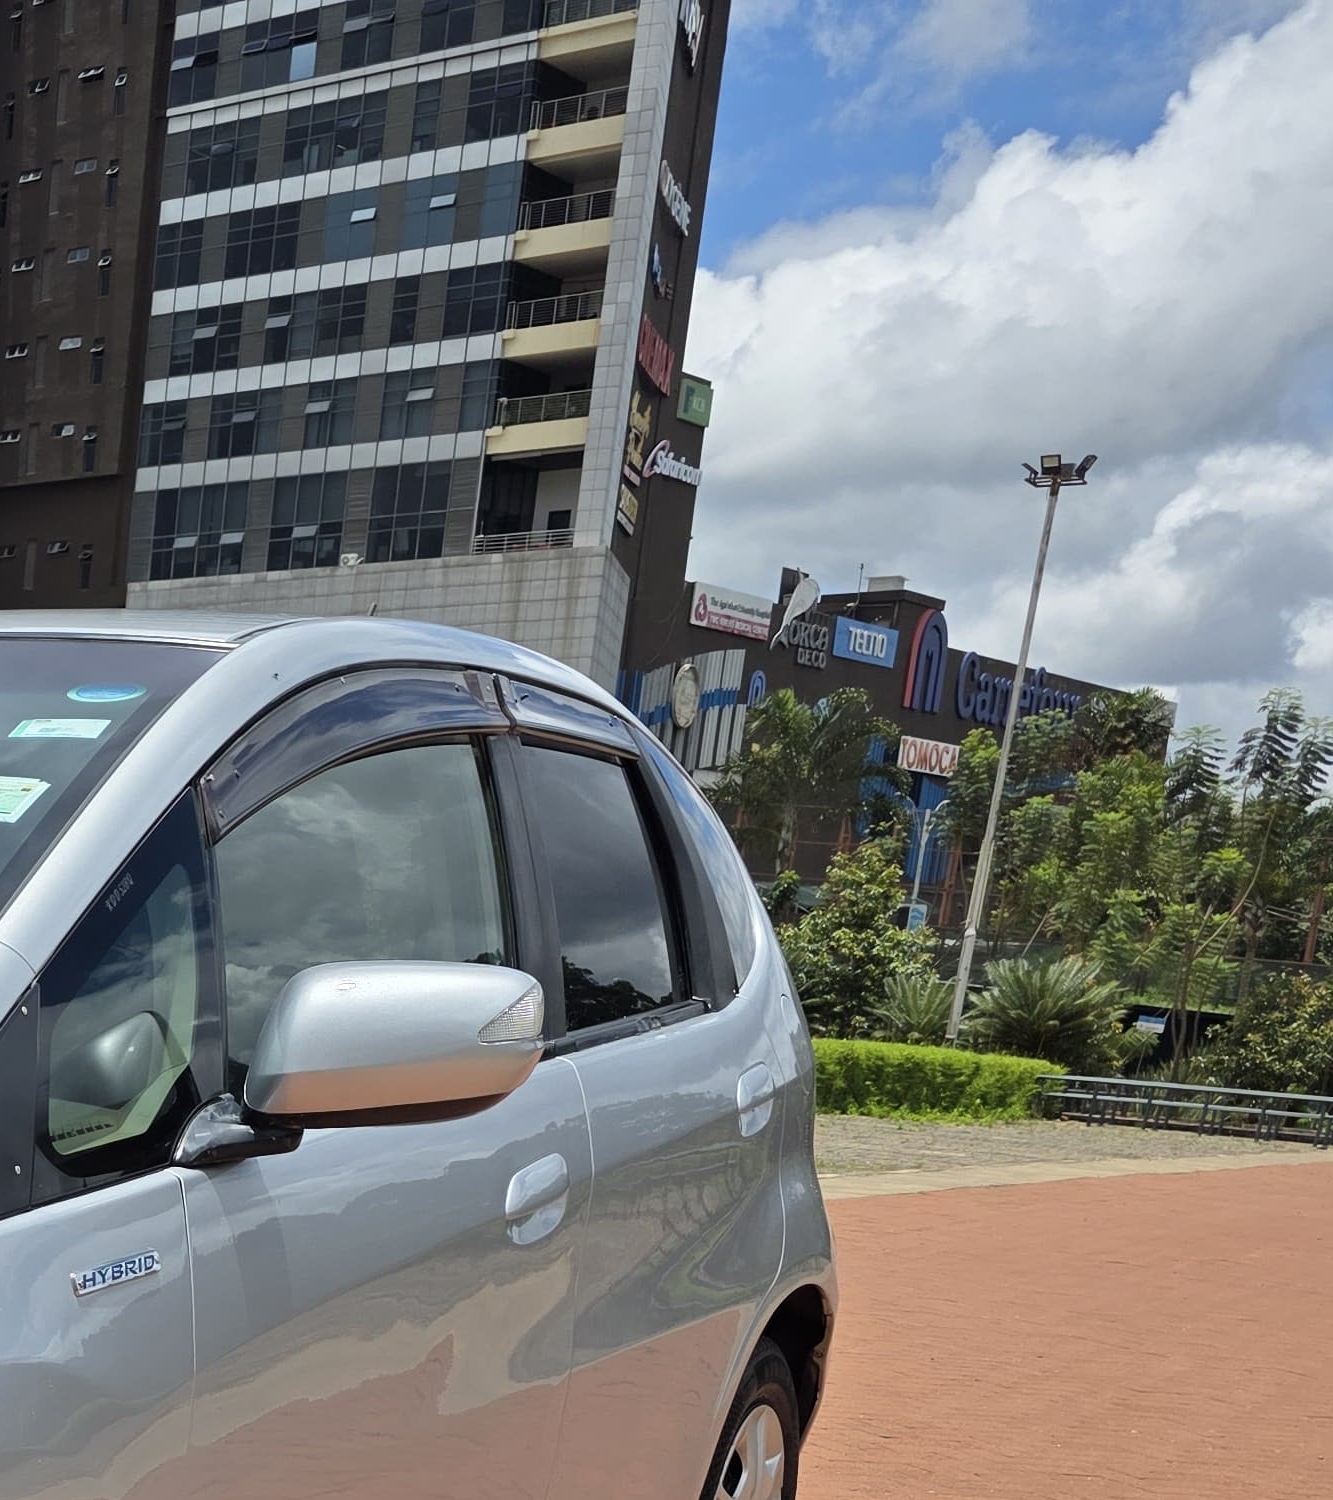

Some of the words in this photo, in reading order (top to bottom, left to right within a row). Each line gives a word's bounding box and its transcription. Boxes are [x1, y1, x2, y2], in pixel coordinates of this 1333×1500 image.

[653, 450, 702, 486] Safaricom
[789, 621, 830, 650] ORCA
[849, 627, 888, 658] TECNO
[797, 648, 827, 669] DECO
[901, 738, 957, 774] TOMOCA
[82, 1254, 156, 1290] HYBRID
